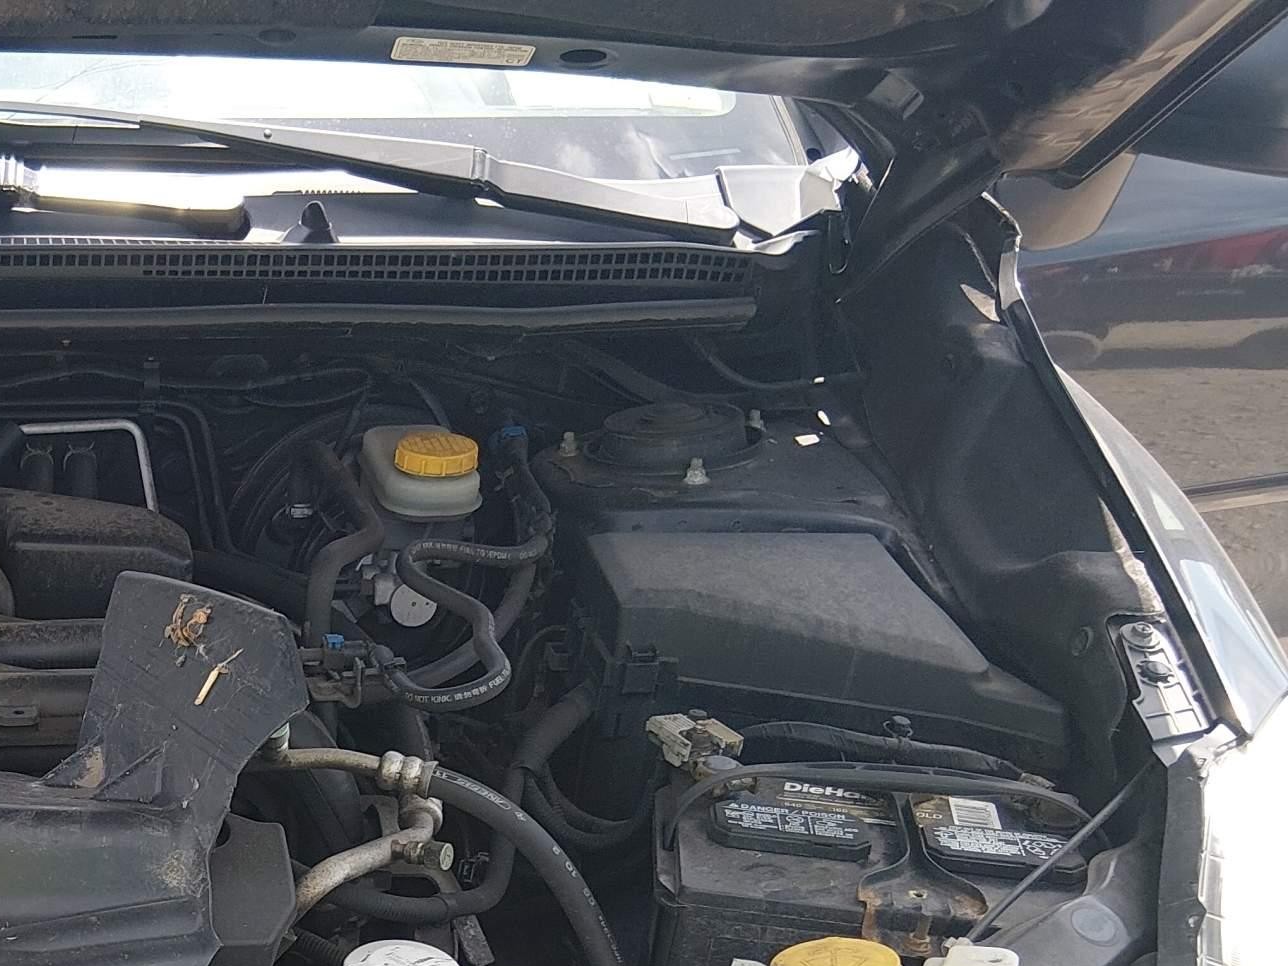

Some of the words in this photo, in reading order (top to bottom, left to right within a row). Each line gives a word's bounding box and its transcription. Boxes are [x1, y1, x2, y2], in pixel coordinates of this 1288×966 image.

[783, 782, 867, 799] DieHa
[739, 803, 789, 815] DANGER
[801, 810, 846, 819] POISON
[915, 811, 943, 820] OLD
